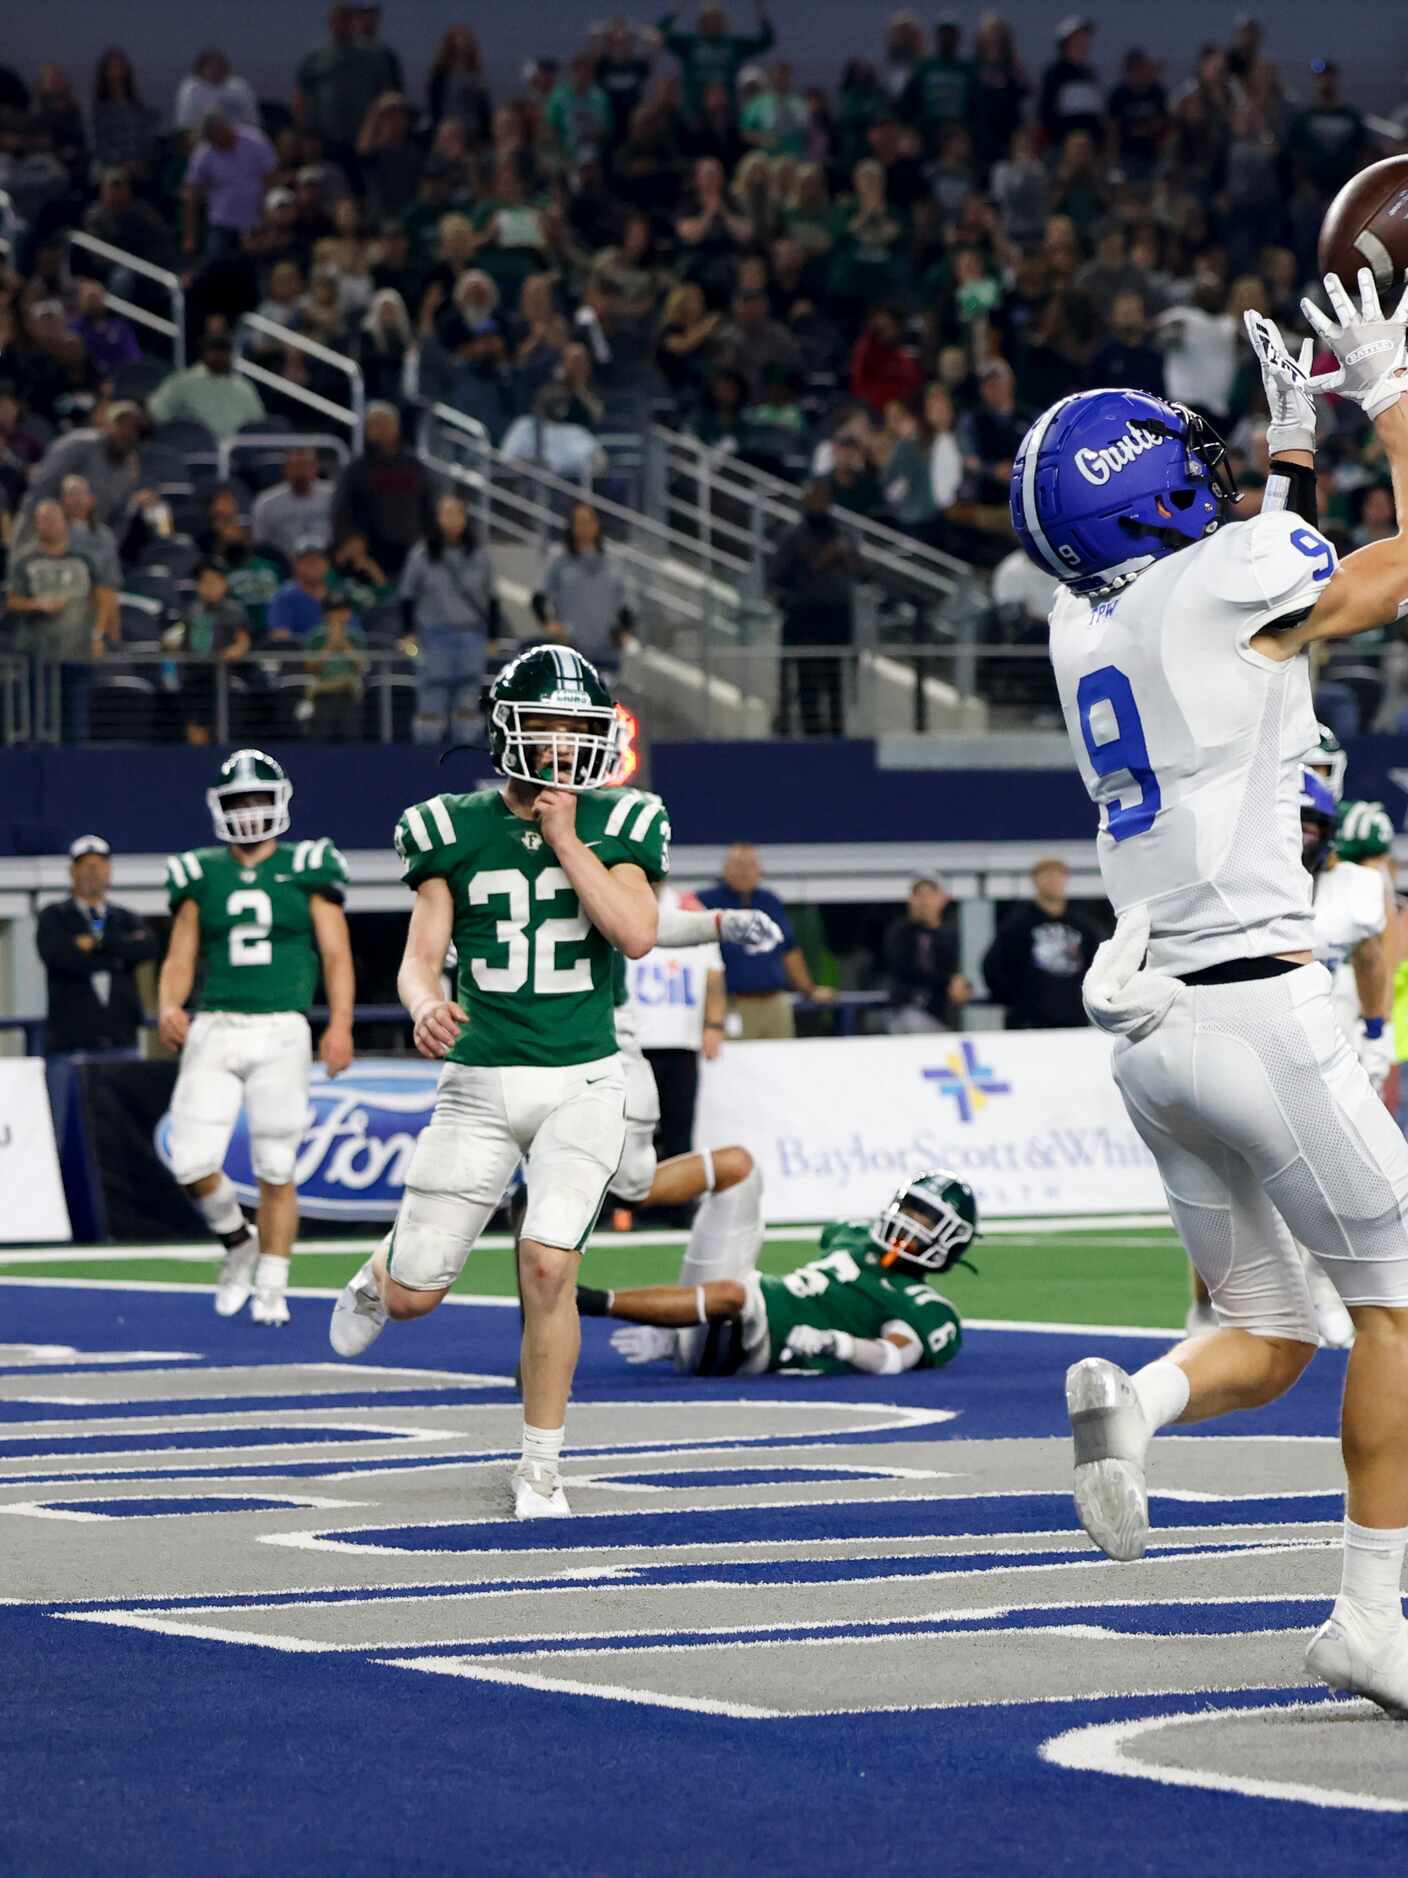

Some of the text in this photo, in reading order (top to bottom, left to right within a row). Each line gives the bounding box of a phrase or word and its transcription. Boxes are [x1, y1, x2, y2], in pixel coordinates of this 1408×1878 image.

[1074, 421, 1173, 486] Gunte
[1058, 544, 1081, 566] 9
[1290, 528, 1336, 582] 9
[1077, 664, 1162, 843] 9
[226, 889, 273, 968] 2
[468, 866, 595, 994] 32
